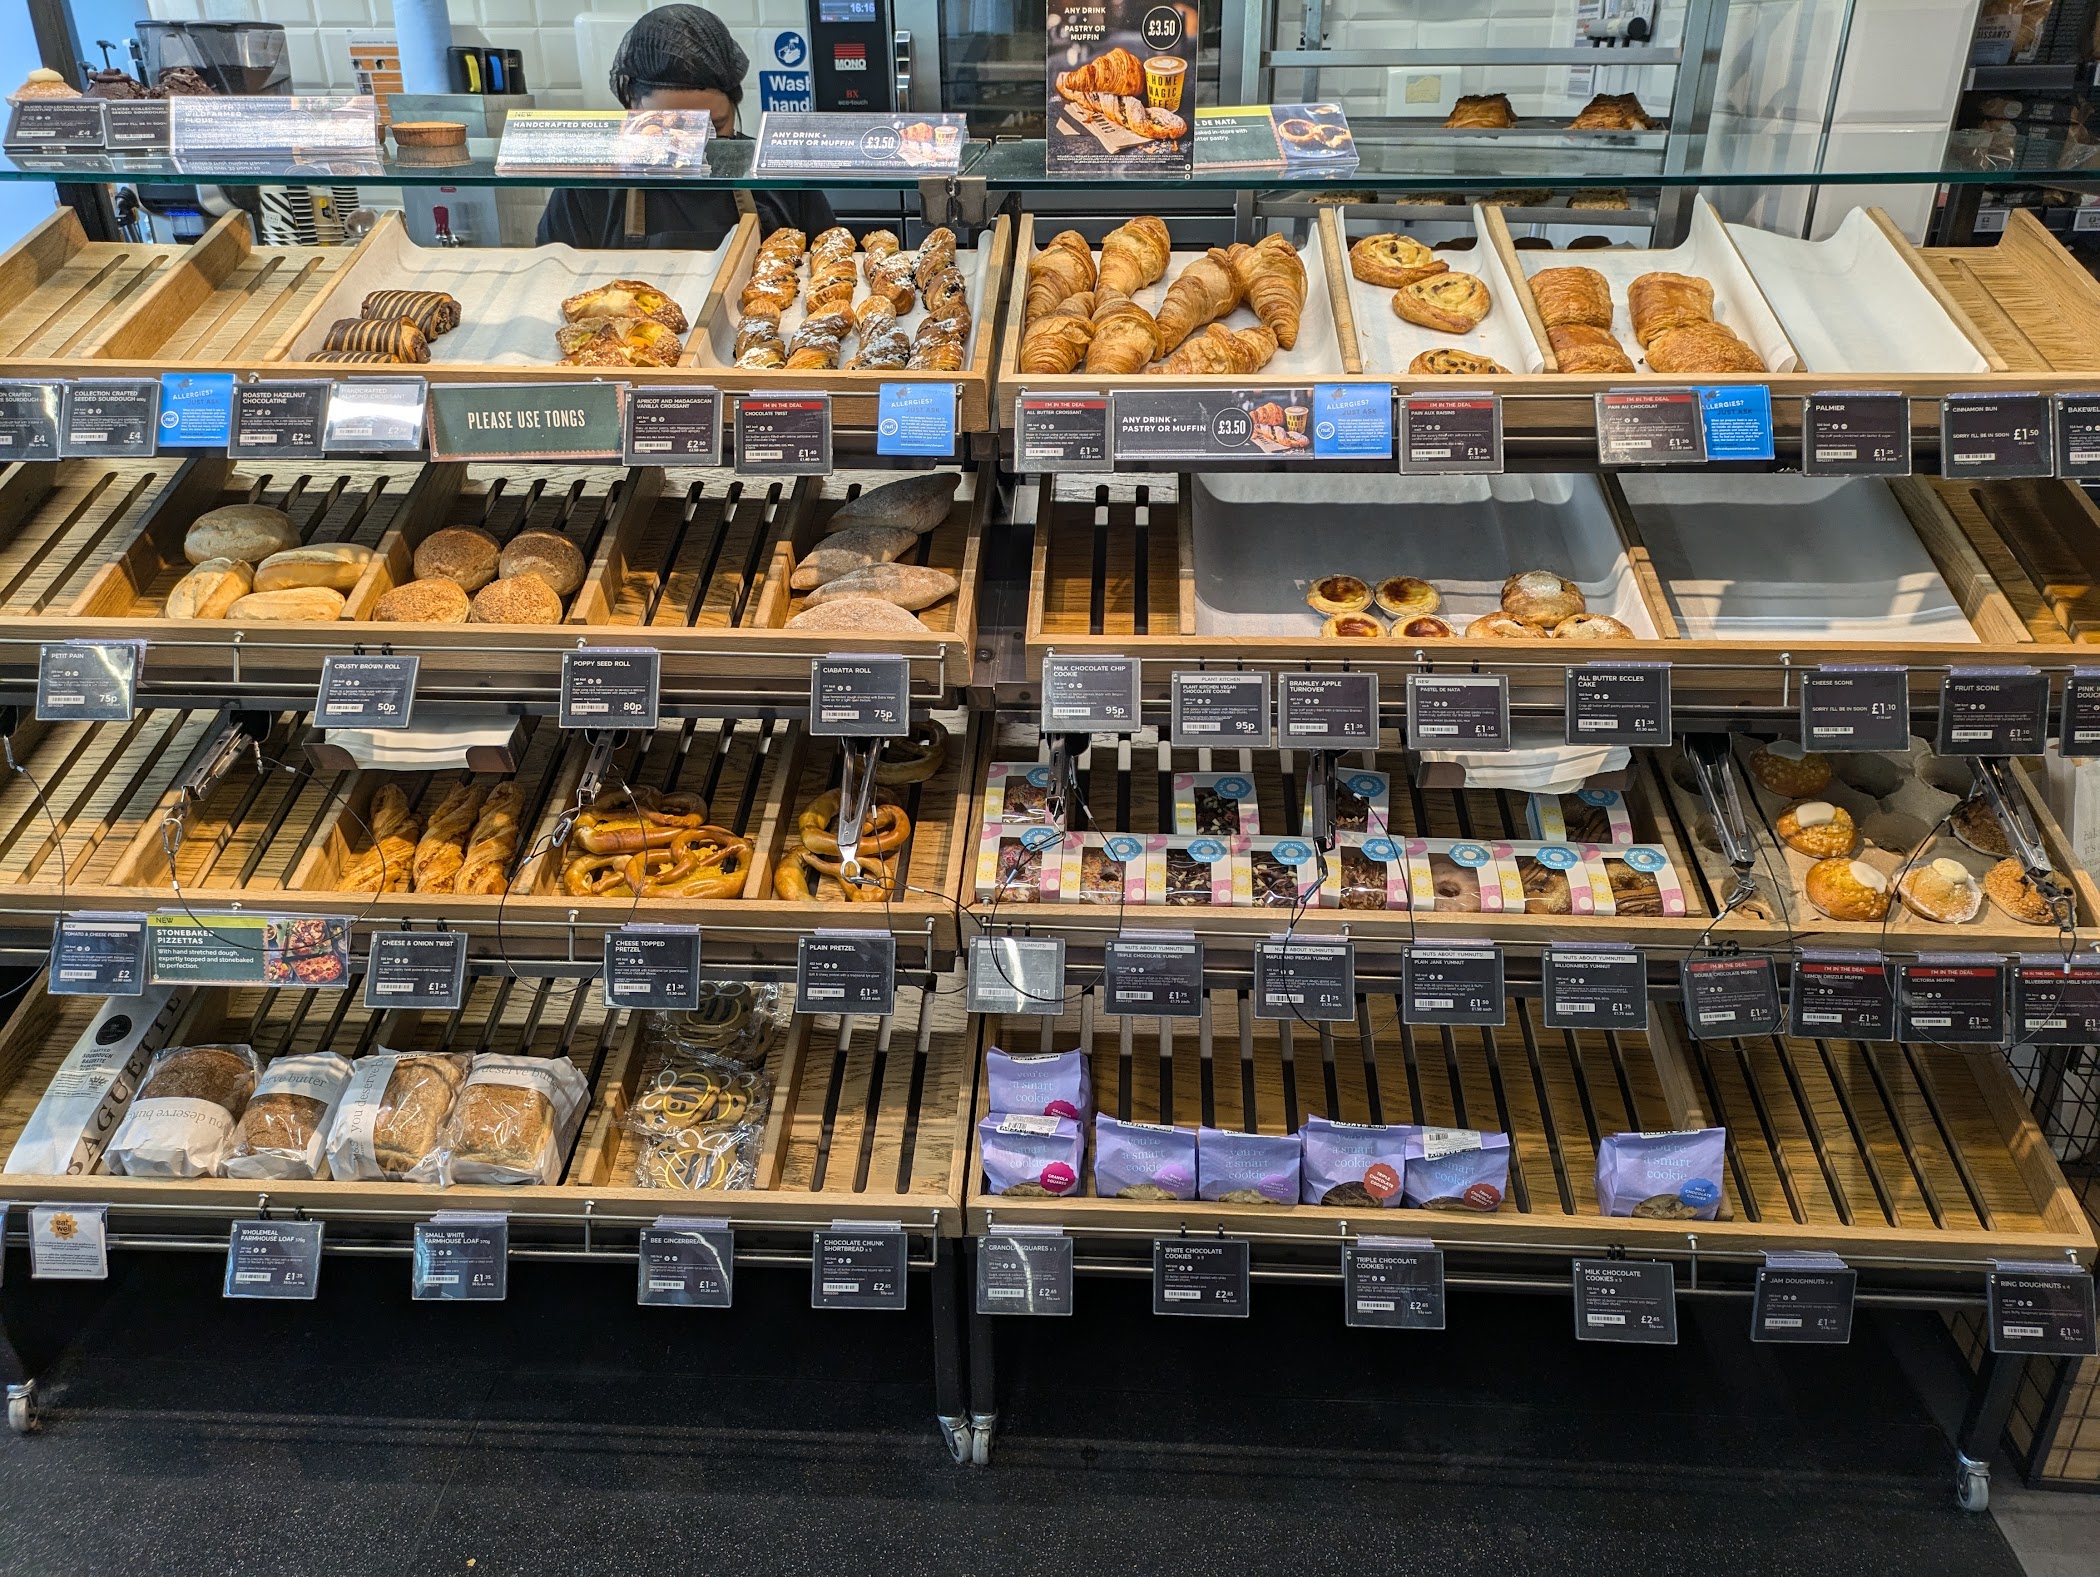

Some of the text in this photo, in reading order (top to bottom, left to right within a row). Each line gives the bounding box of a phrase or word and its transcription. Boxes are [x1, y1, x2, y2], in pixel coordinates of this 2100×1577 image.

[850, 3, 875, 13] 16:16
[1064, 25, 1093, 33] PASTRY
[1148, 20, 1176, 37] £3.50
[834, 59, 867, 69] MONO
[1152, 75, 1178, 86] HOME
[846, 90, 859, 98] BX
[1149, 85, 1177, 97] MAGIC
[1214, 118, 1237, 126] NATA
[864, 136, 896, 149] £3.50
[891, 398, 933, 408] ALLERGIES?
[467, 409, 586, 430] PLEASE USE TONGS
[1122, 424, 1207, 433] PASTRY OR MUFFIN
[1218, 420, 1246, 435] £3.50
[128, 431, 141, 440] £4
[1873, 448, 1894, 457] £1.25
[99, 694, 117, 704] 75p
[377, 703, 396, 713] 50p
[623, 702, 642, 712] 80p
[1105, 706, 1125, 717] 95p
[873, 709, 893, 720] 75p
[1474, 725, 1494, 733] £1.10
[2009, 729, 2030, 737] £1.10
[157, 929, 215, 937] STONEBAKED
[157, 936, 204, 944] PIZZETTAS
[218, 949, 239, 957] dough,
[166, 962, 199, 970] perfection.
[288, 1073, 327, 1088] butter
[157, 1108, 206, 1122] deserve
[1644, 1157, 1691, 1168] a smart
[1047, 1174, 1069, 1182] GRANOLA
[1647, 1169, 1688, 1181] cookie
[56, 1225, 71, 1233] well
[1584, 1268, 1641, 1278] MILK CHOCOLATE
